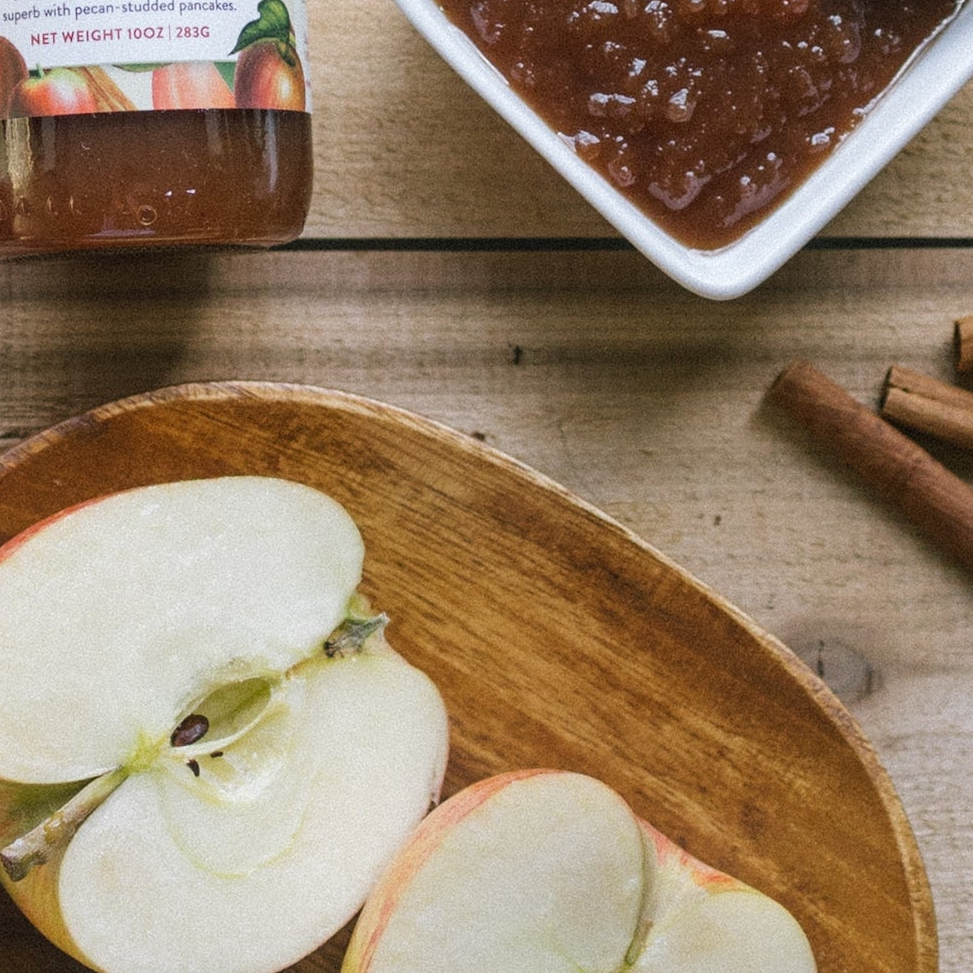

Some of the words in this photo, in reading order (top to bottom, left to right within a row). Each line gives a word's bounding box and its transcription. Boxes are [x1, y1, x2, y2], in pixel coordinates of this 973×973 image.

[3, 6, 40, 24] superb
[44, 4, 71, 17] with
[31, 33, 57, 45] NET
[62, 29, 122, 43] WEIGHT
[176, 26, 210, 38] 283G
